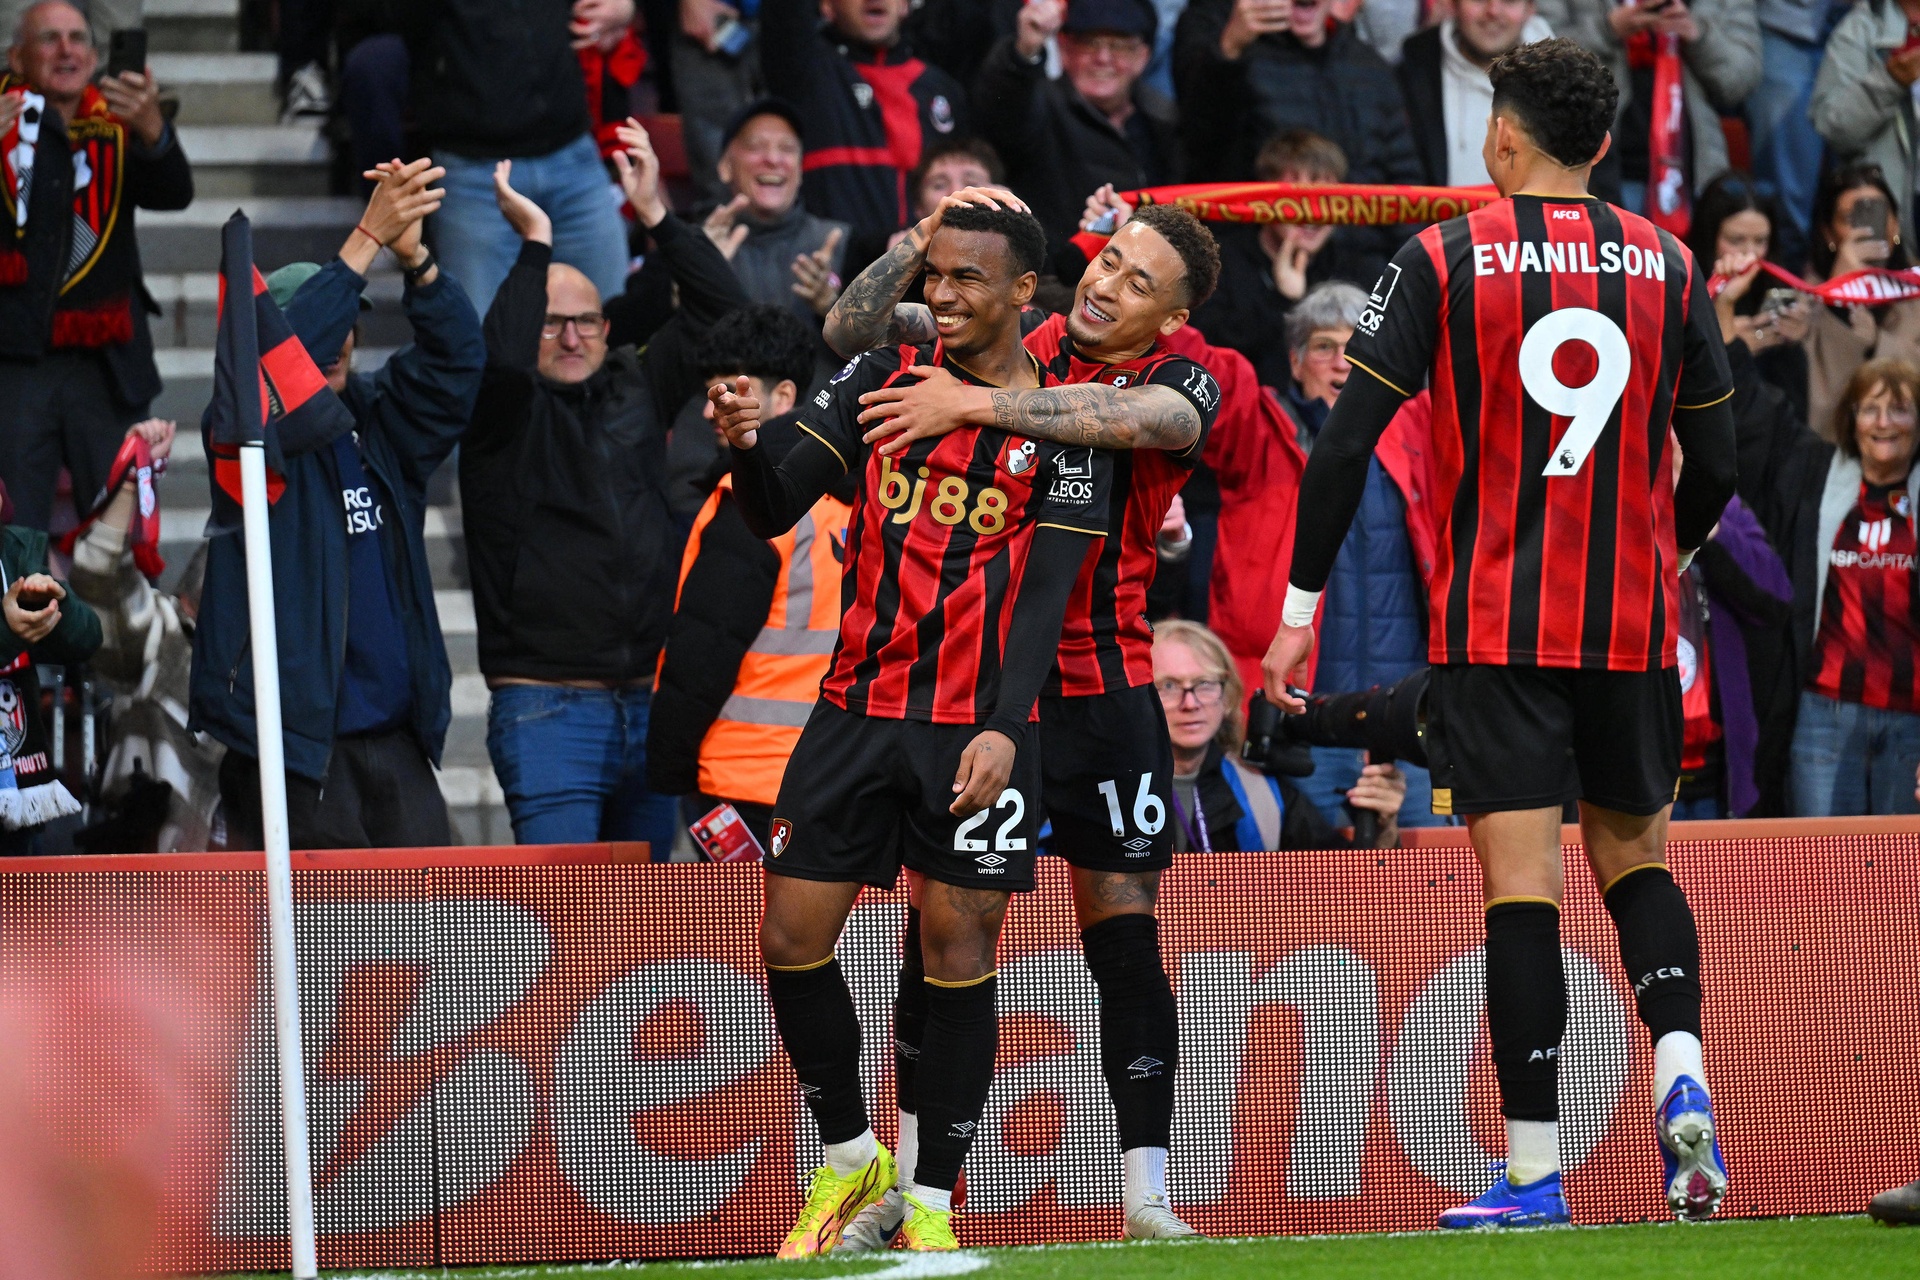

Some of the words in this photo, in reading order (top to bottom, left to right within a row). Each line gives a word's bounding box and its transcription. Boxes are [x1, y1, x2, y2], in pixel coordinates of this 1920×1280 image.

[1247, 195, 1485, 226] BOURNEMO
[1552, 209, 1581, 221] AFCB
[1473, 241, 1666, 282] EVANILSON
[1518, 306, 1632, 477] 9
[877, 455, 1009, 536] bj88
[1048, 479, 1093, 499] LEOS
[1830, 549, 1918, 571] SPCAPITA
[1097, 771, 1167, 837] 16
[953, 788, 1028, 852] 22
[1124, 851, 1151, 859] umbro
[977, 867, 1005, 875] umbro
[1634, 966, 1686, 997] AFCB
